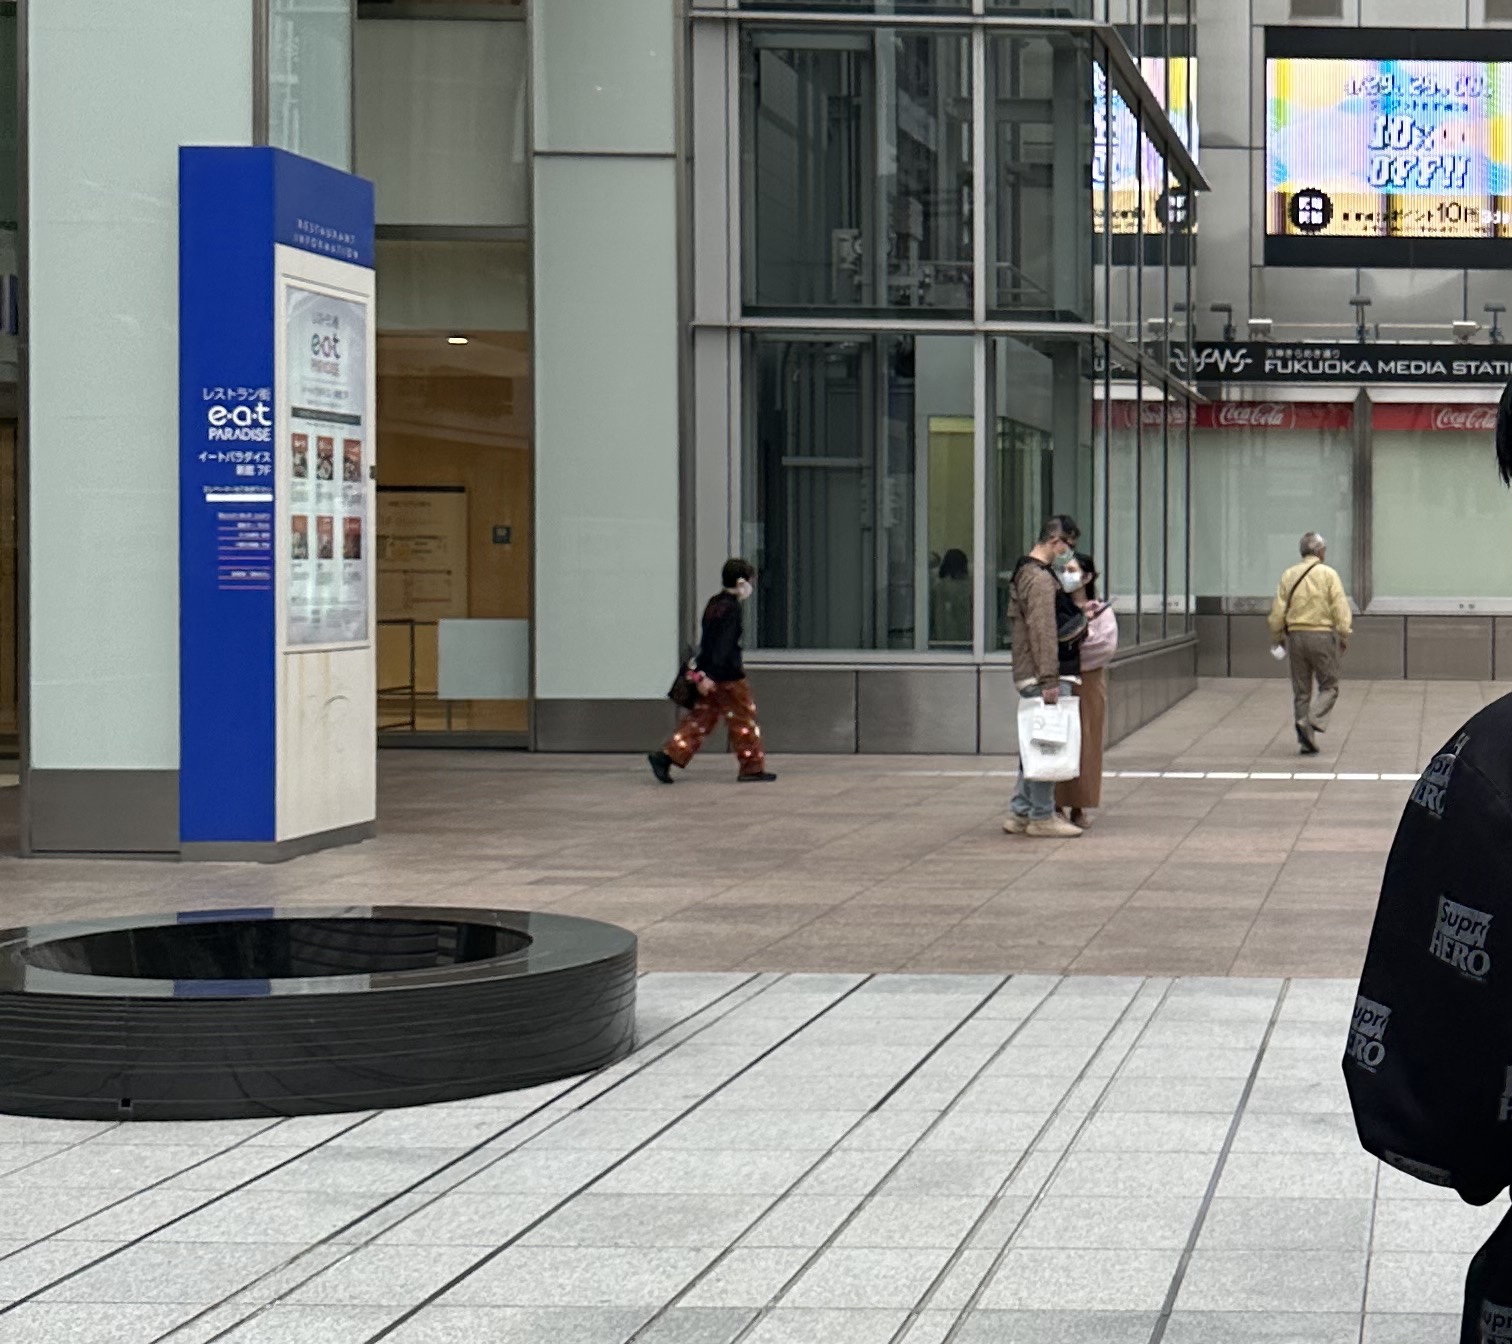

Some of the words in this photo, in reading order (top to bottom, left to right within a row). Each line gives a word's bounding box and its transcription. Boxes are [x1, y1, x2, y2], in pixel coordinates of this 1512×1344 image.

[1264, 359, 1373, 375] FUKUOKA
[1378, 360, 1447, 375] MEDIA
[208, 427, 271, 441] PARADISE
[1429, 932, 1490, 977] HERO
